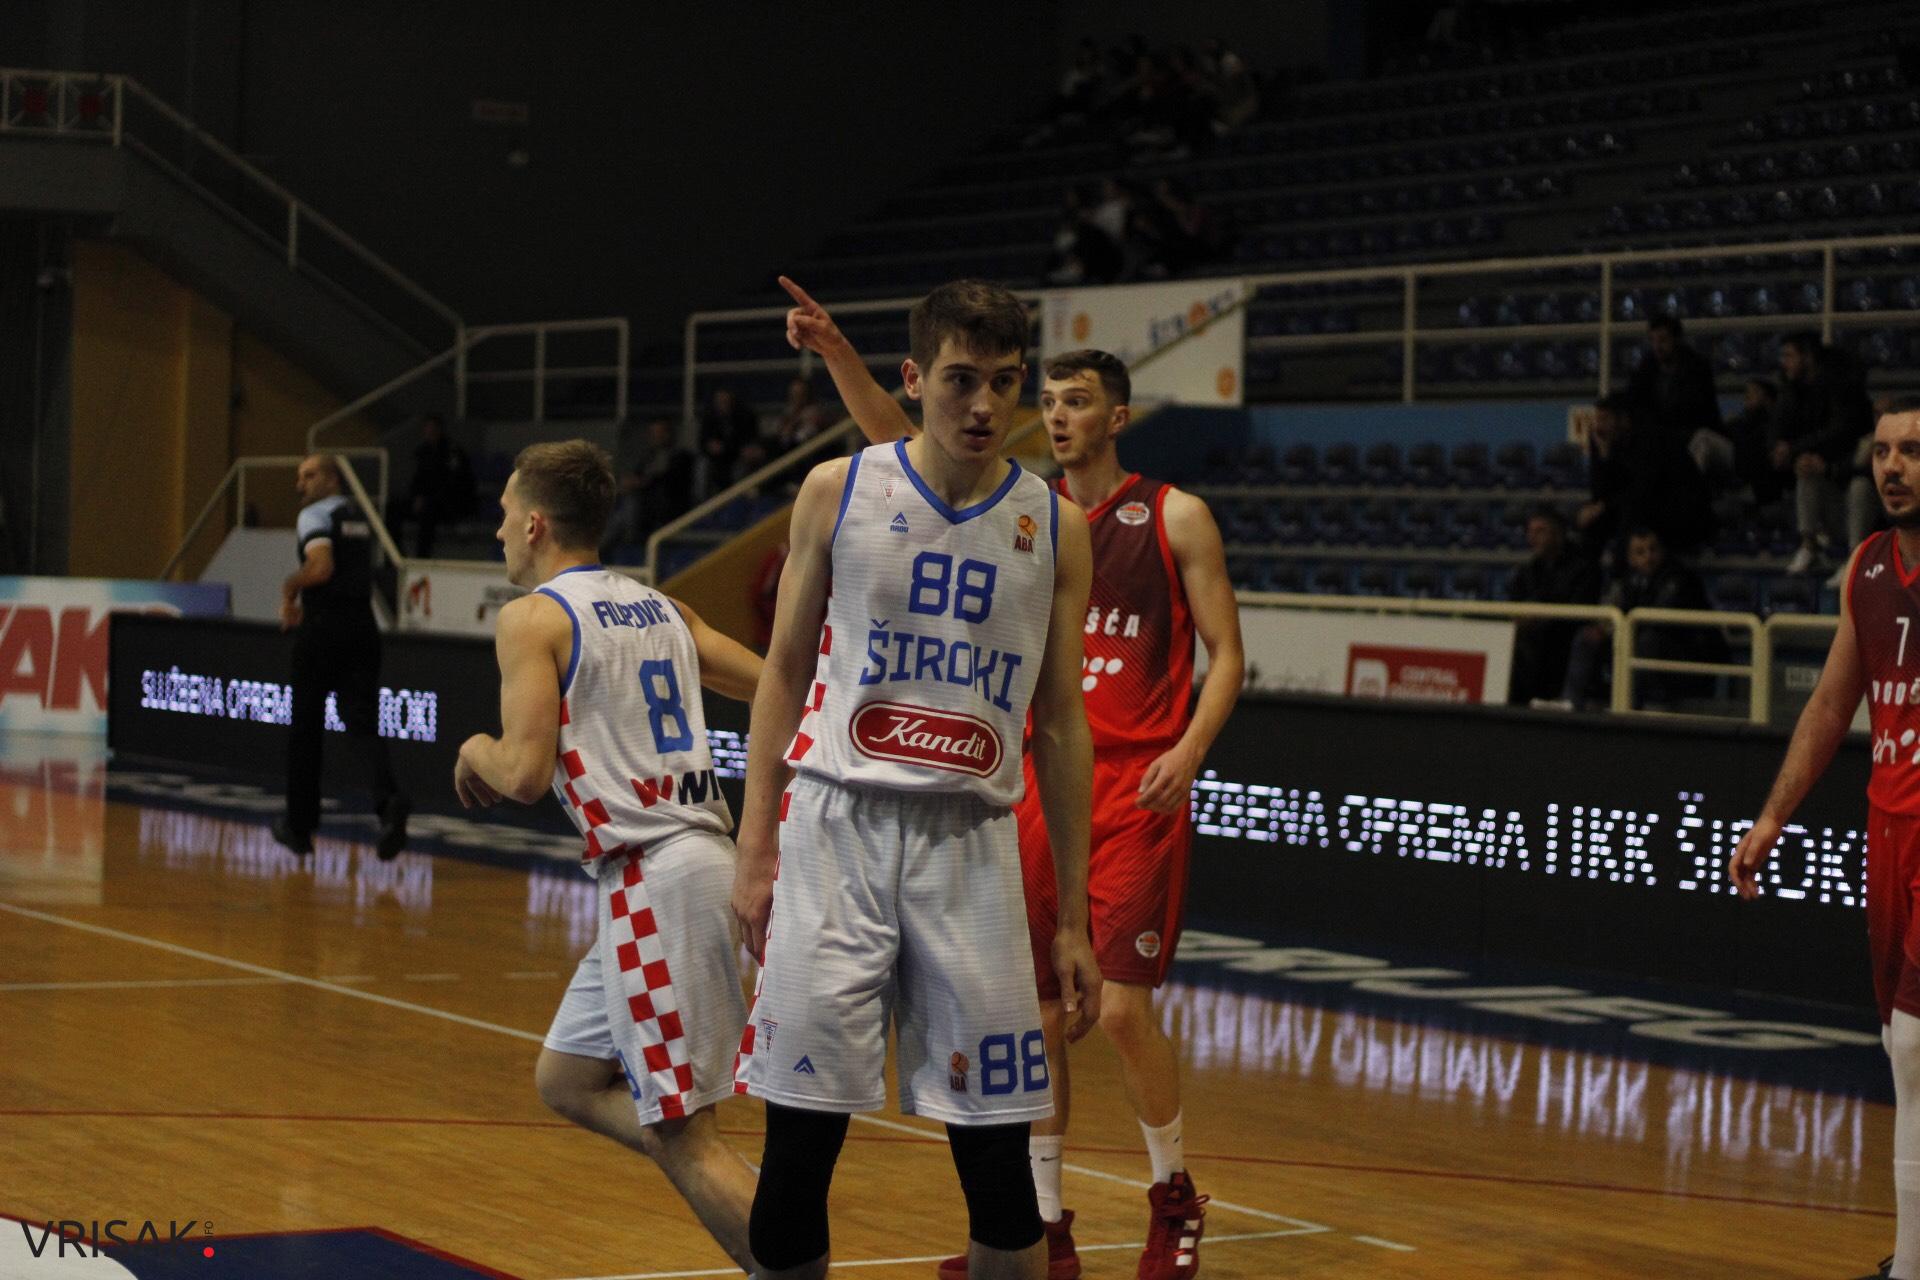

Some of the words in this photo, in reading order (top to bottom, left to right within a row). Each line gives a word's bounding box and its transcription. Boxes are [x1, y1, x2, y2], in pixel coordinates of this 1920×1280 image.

[908, 551, 997, 624] 88
[1083, 606, 1141, 638] ŠĆA
[858, 618, 1022, 713] ŠIROKI
[1896, 616, 1910, 667] 7
[639, 659, 693, 754] 8
[868, 715, 986, 761] Kandit
[1190, 769, 1330, 849] ŽBENA
[1338, 793, 1531, 872] OPREMA
[979, 1029, 1050, 1095] 88
